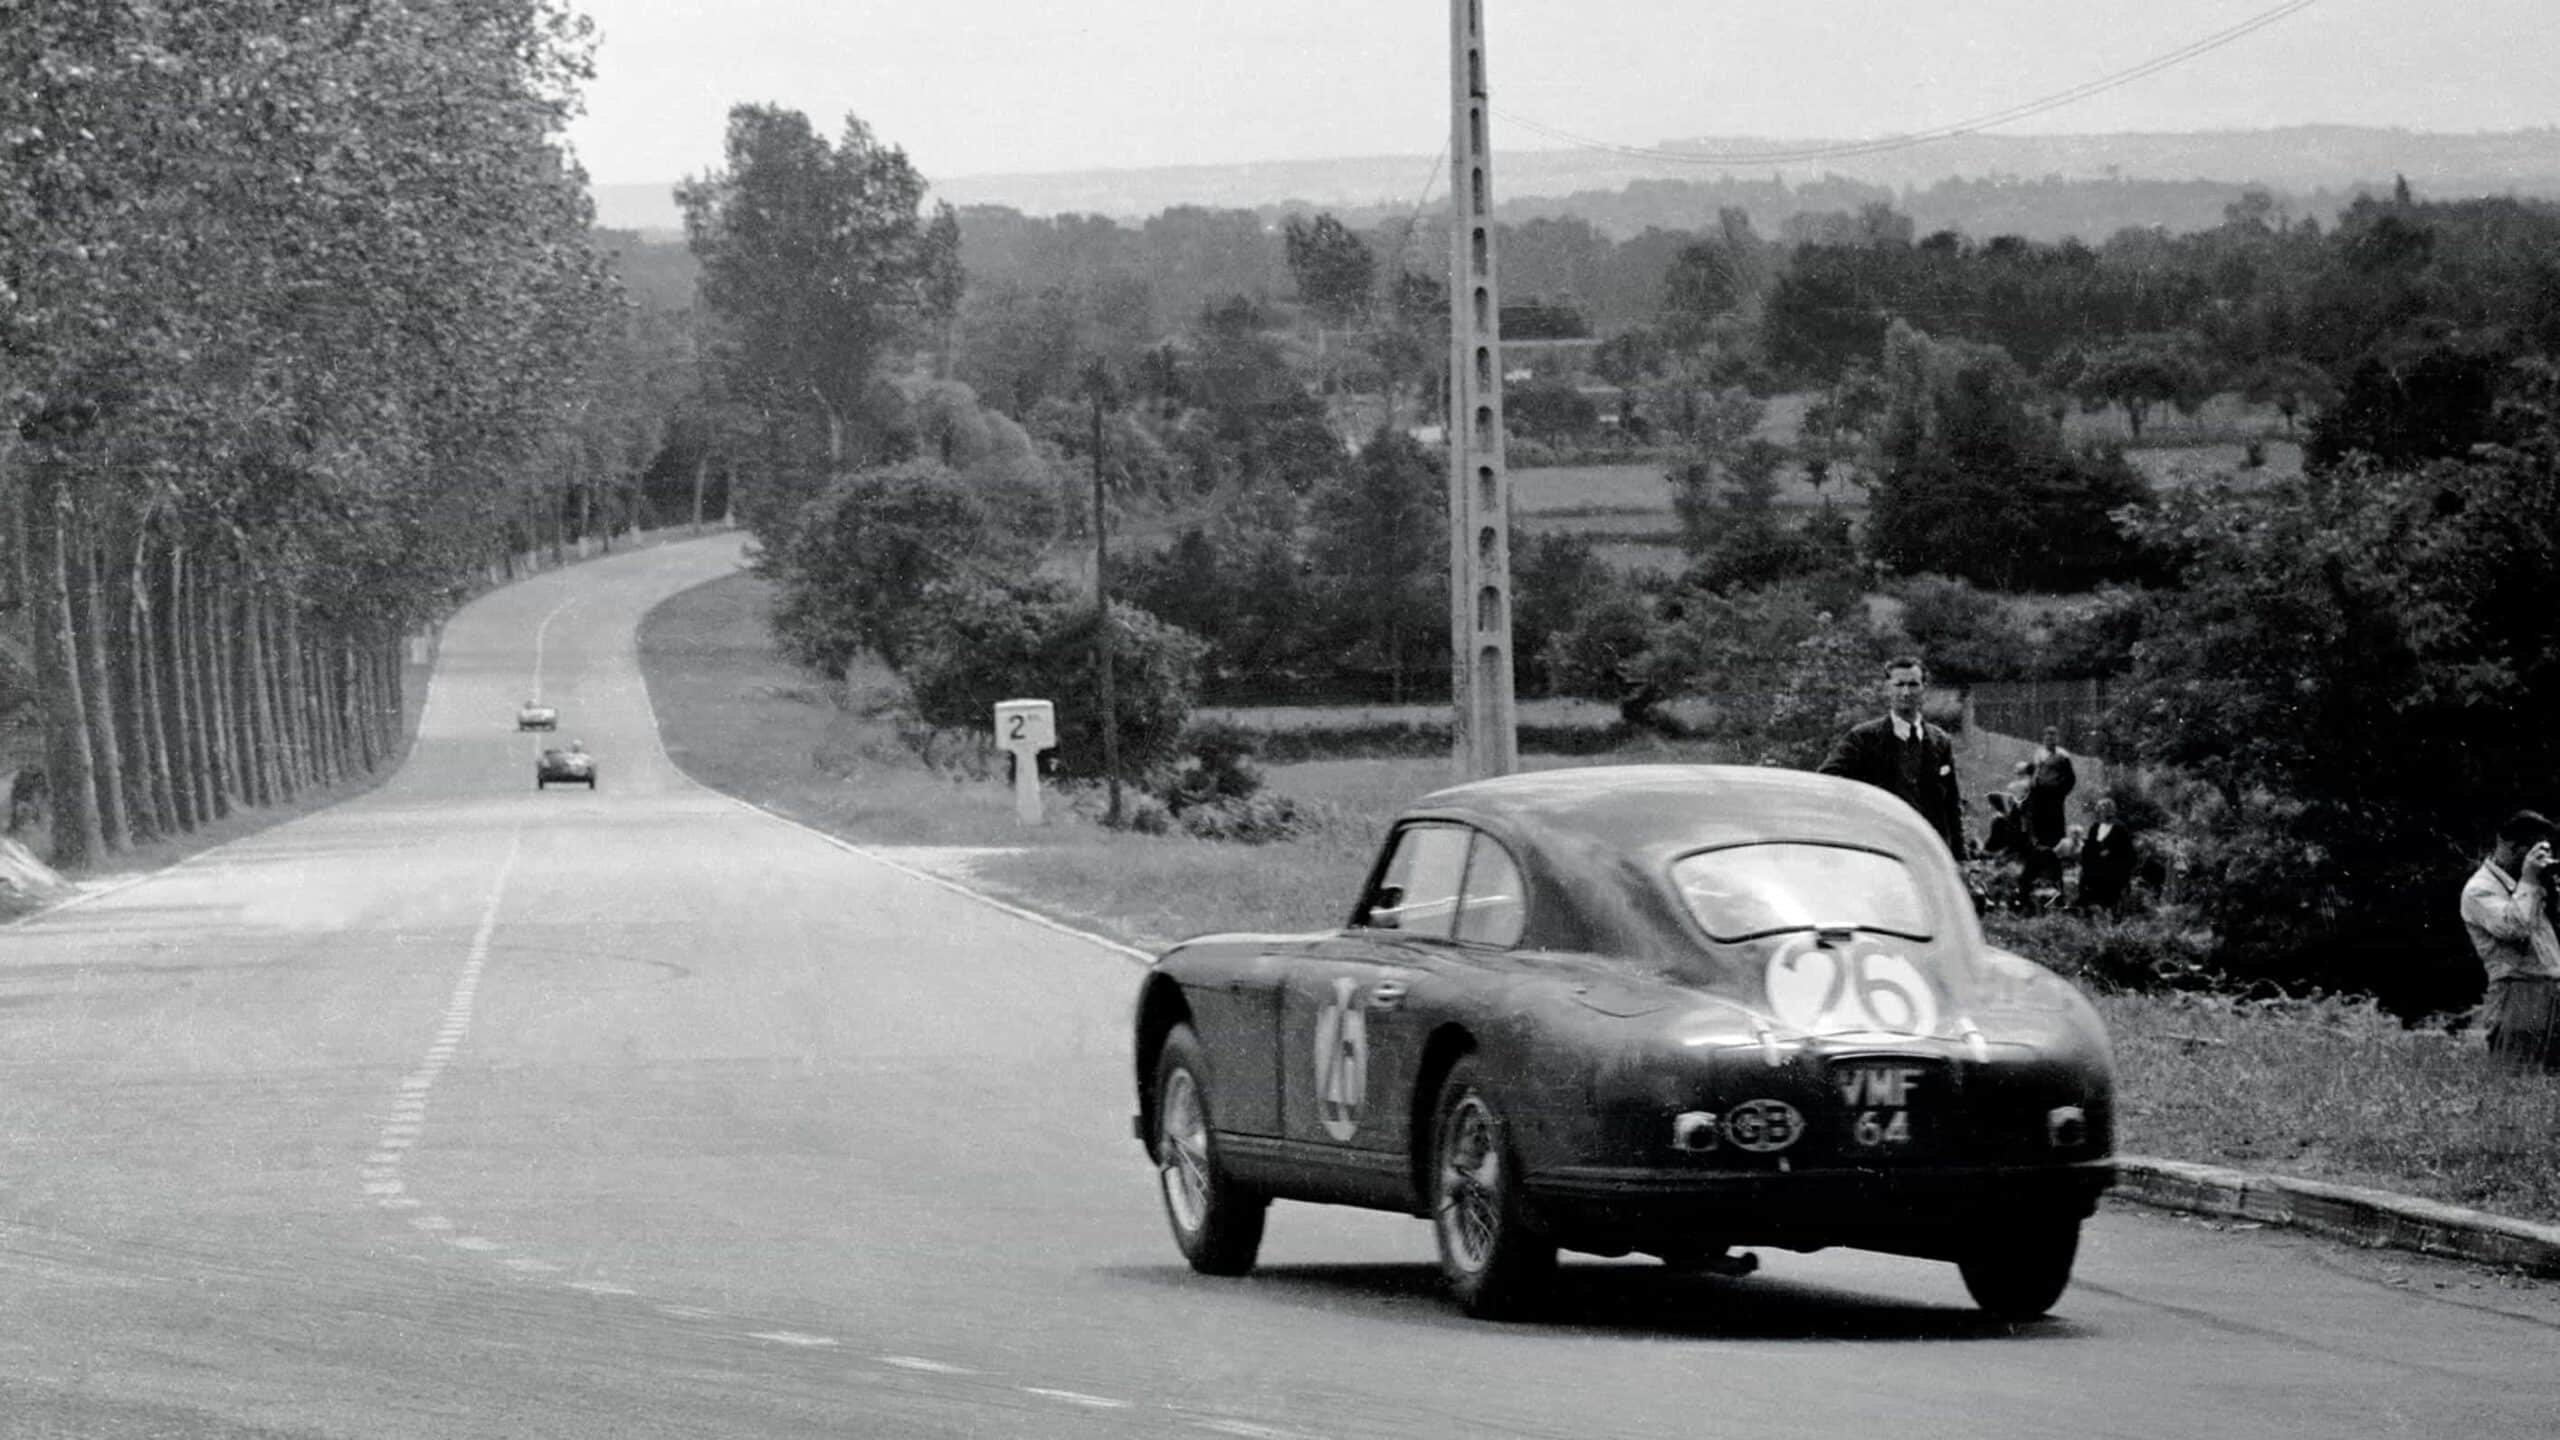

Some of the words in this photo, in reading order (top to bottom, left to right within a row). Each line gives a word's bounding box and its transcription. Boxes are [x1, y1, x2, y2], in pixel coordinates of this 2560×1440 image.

[1009, 714, 1026, 740] 2
[1782, 940, 1918, 1031] 26
[1838, 1068, 1925, 1106] VMF
[1730, 1106, 1792, 1144] GB
[1854, 1110, 1912, 1146] 64
